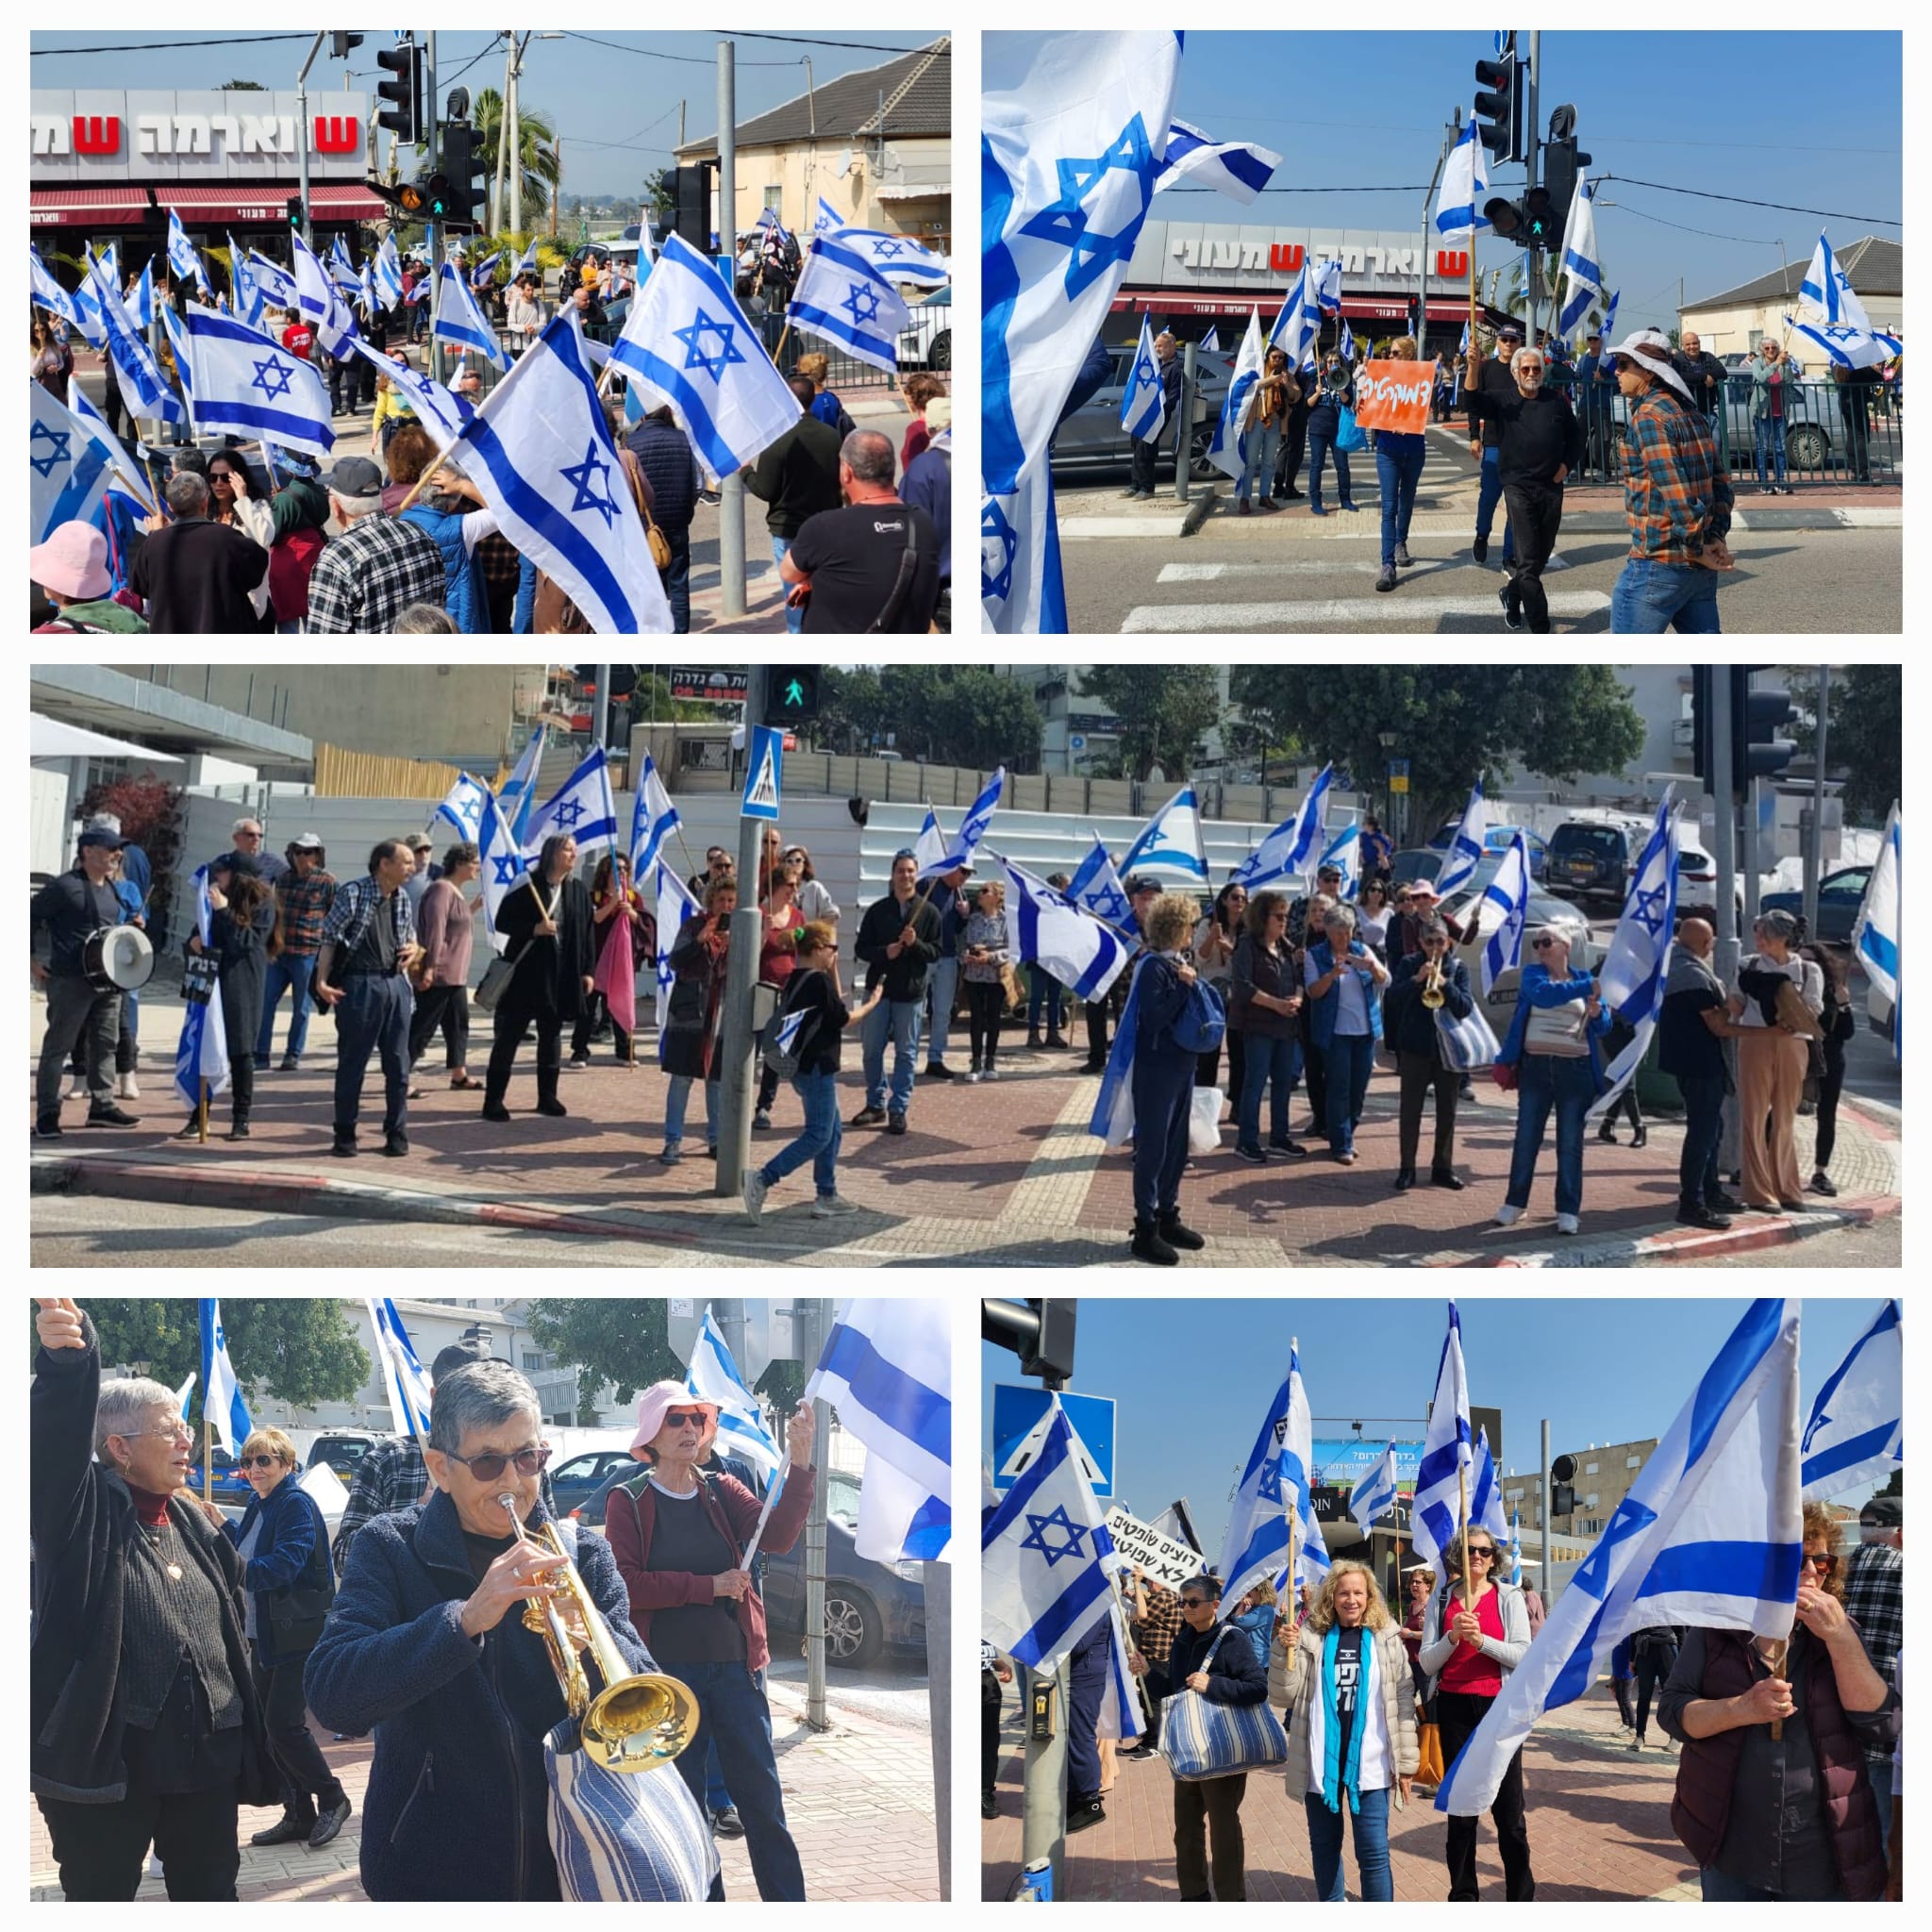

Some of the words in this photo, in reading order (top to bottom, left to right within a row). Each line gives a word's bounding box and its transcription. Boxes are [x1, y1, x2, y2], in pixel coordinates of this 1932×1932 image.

[1172, 240, 1305, 272] שמעוני
[674, 672, 706, 685] גדרה
[1353, 1451, 1382, 1461] דרום?
[1395, 1452, 1416, 1461] בדר
[1159, 1541, 1198, 1568] רוצים
[1155, 1562, 1186, 1583] לא
